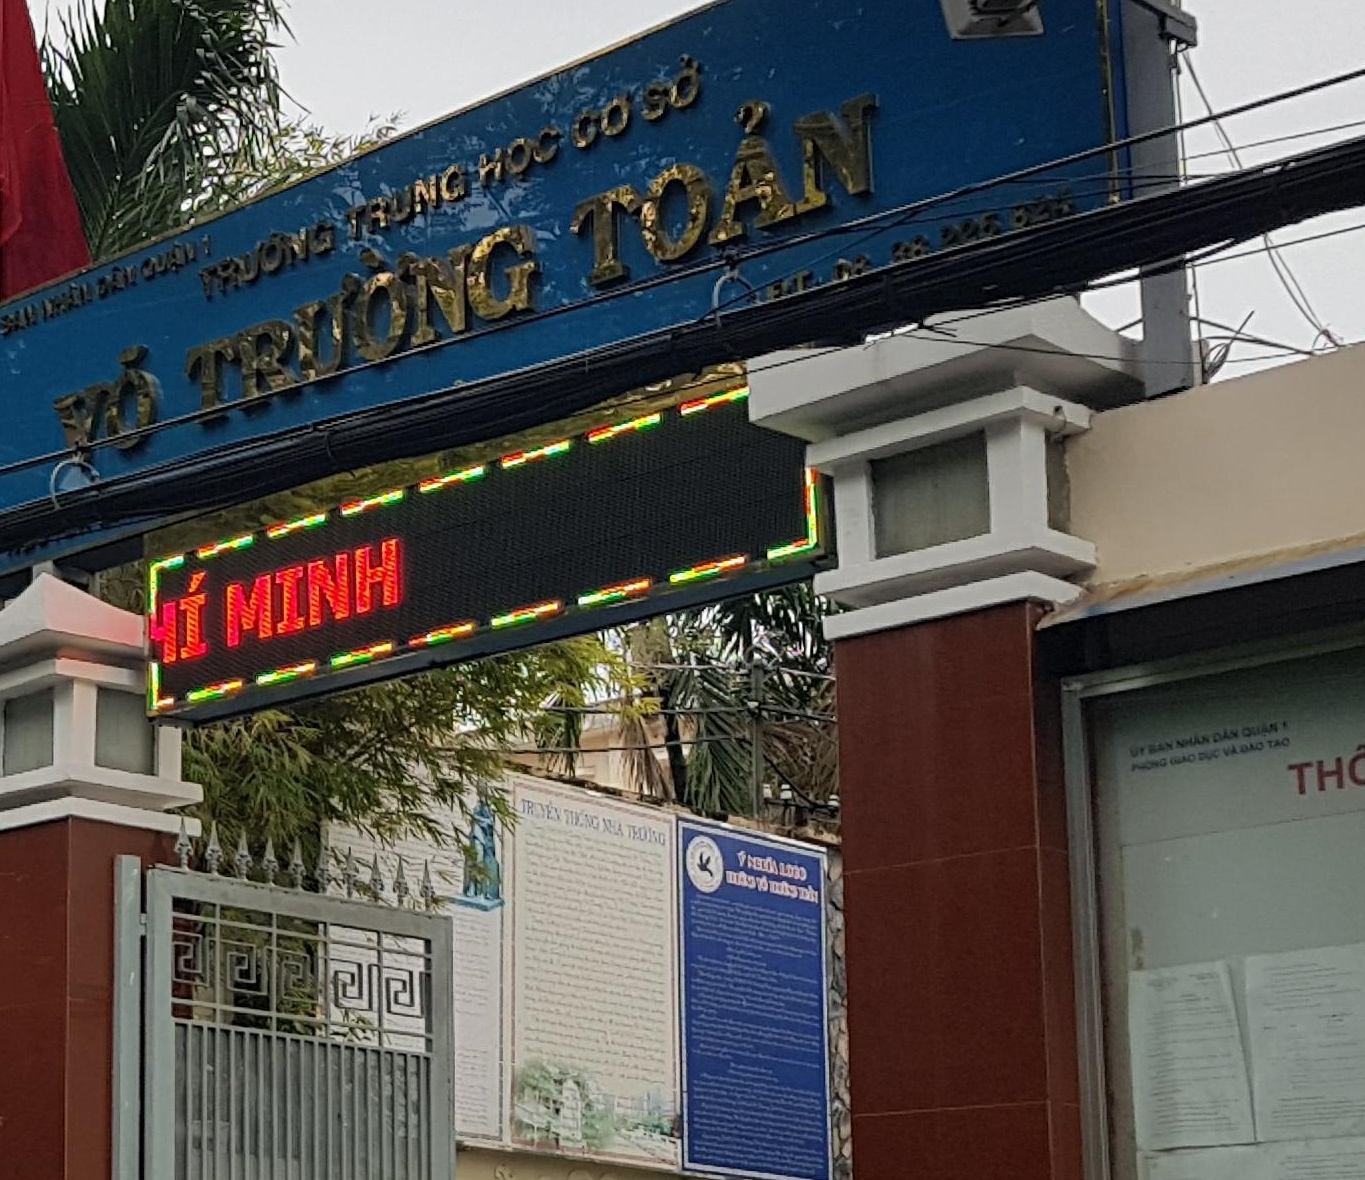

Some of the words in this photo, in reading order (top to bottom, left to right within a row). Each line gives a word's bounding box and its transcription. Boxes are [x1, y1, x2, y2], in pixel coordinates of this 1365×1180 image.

[343, 163, 469, 243] TRUNG
[184, 224, 539, 427] TRƯỜNG
[569, 92, 880, 291] TOẢN
[225, 537, 402, 649] MINH
